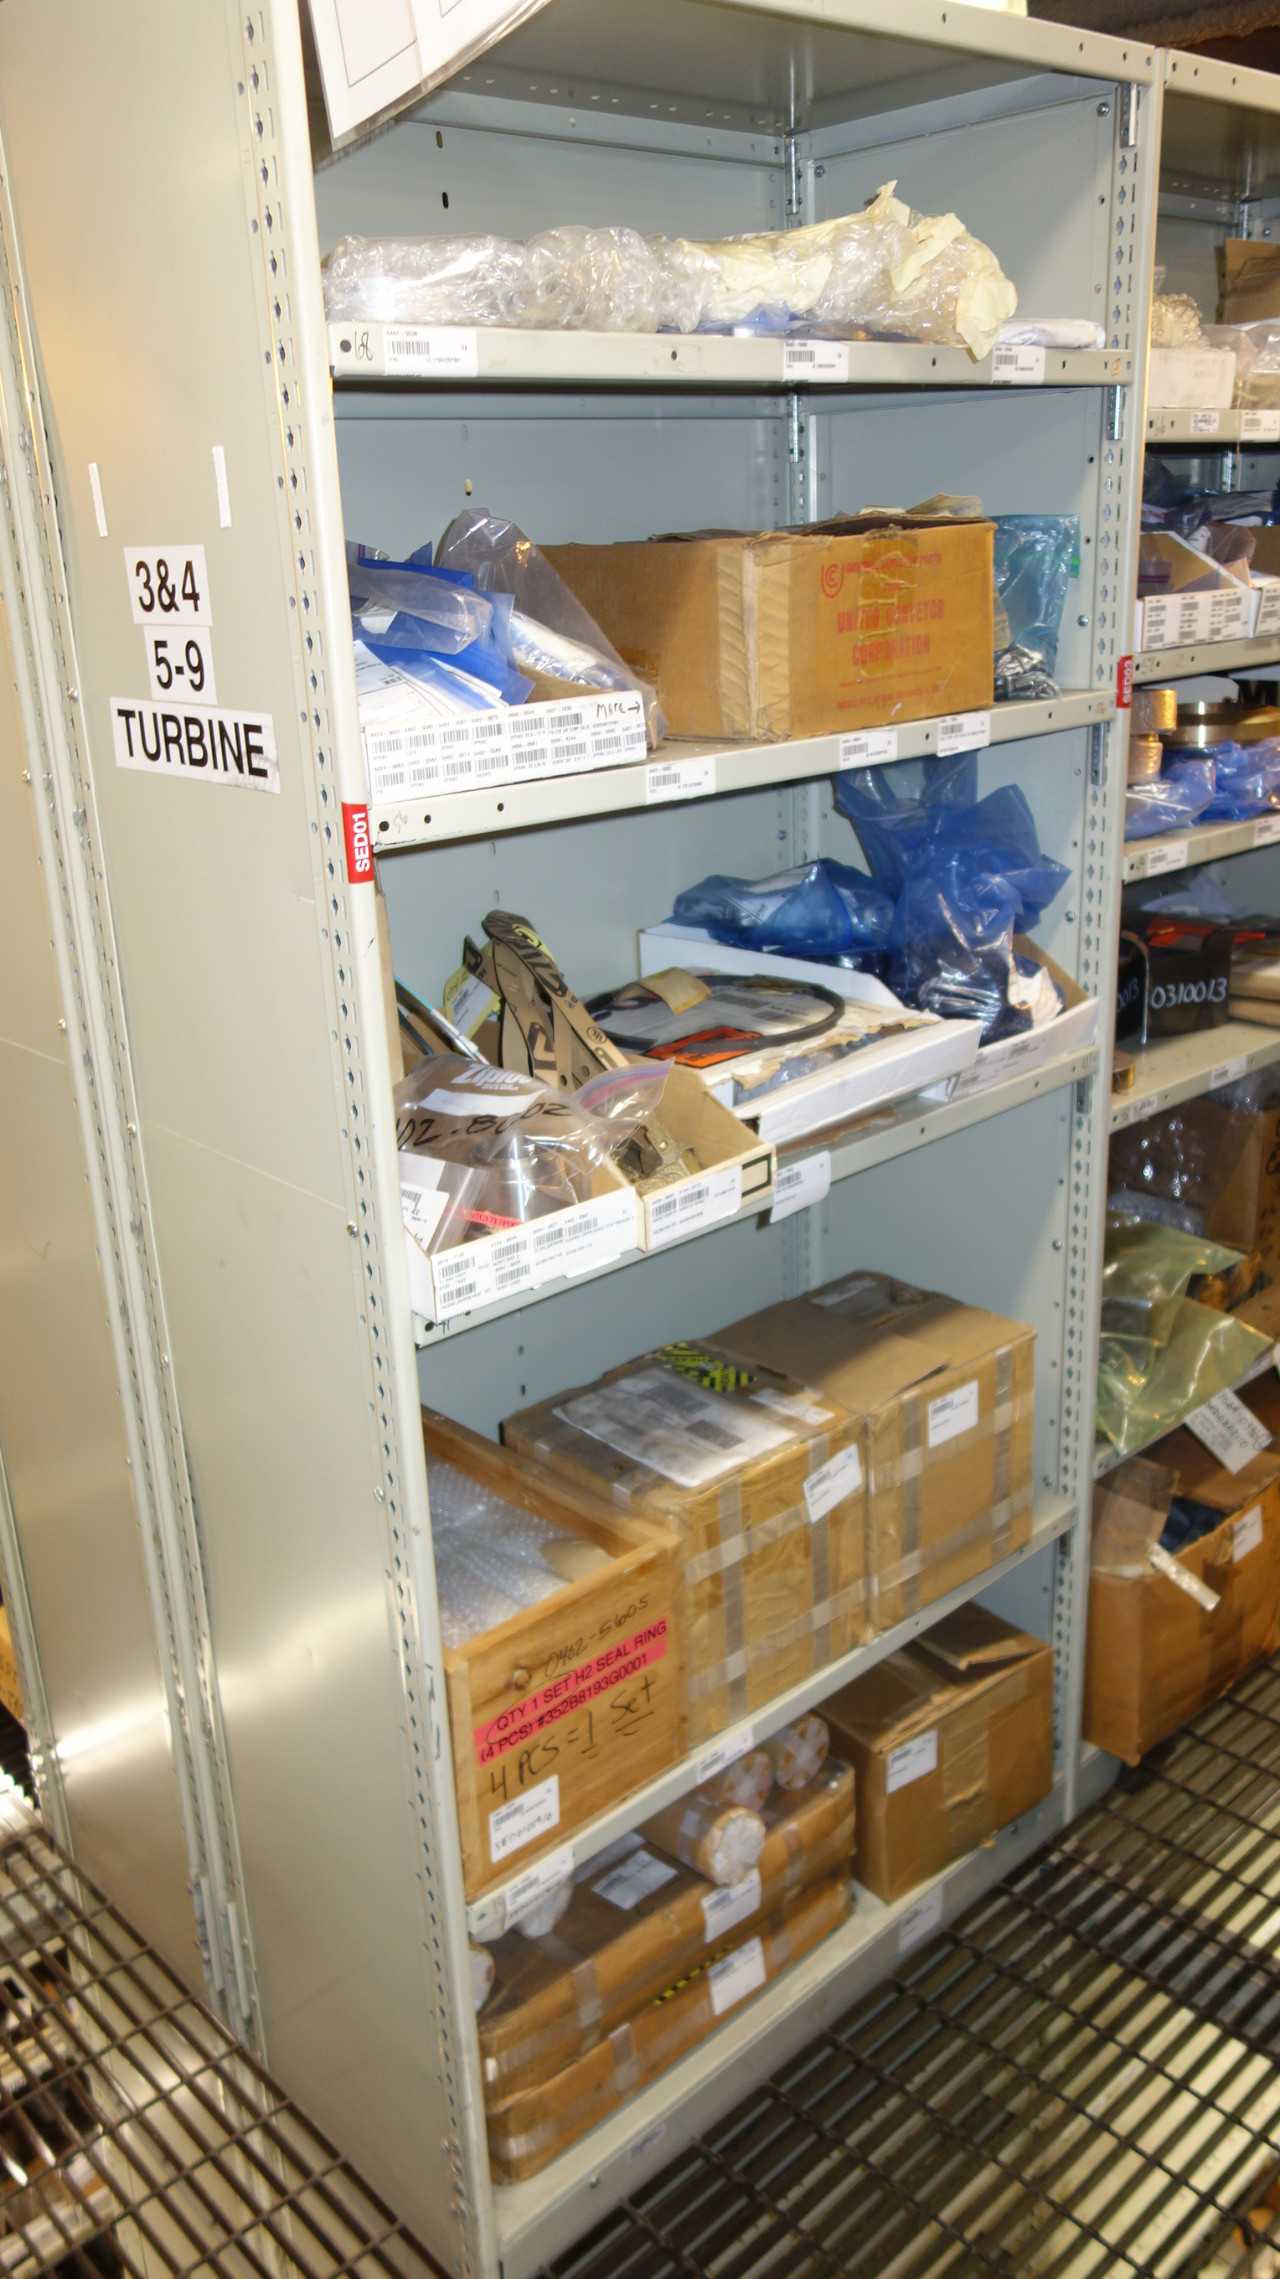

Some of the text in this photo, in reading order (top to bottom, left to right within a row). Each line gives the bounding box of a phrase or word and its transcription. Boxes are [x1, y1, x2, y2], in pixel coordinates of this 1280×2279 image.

[135, 558, 200, 613] 3&4
[153, 639, 206, 692] 5-9
[117, 708, 269, 778] TURBINE
[354, 811, 371, 873] SED01
[1150, 976, 1228, 1009] 0310013
[496, 1619, 668, 1731] QTY 1 SET H2 SEAL RING
[490, 1765, 508, 1800] 4
